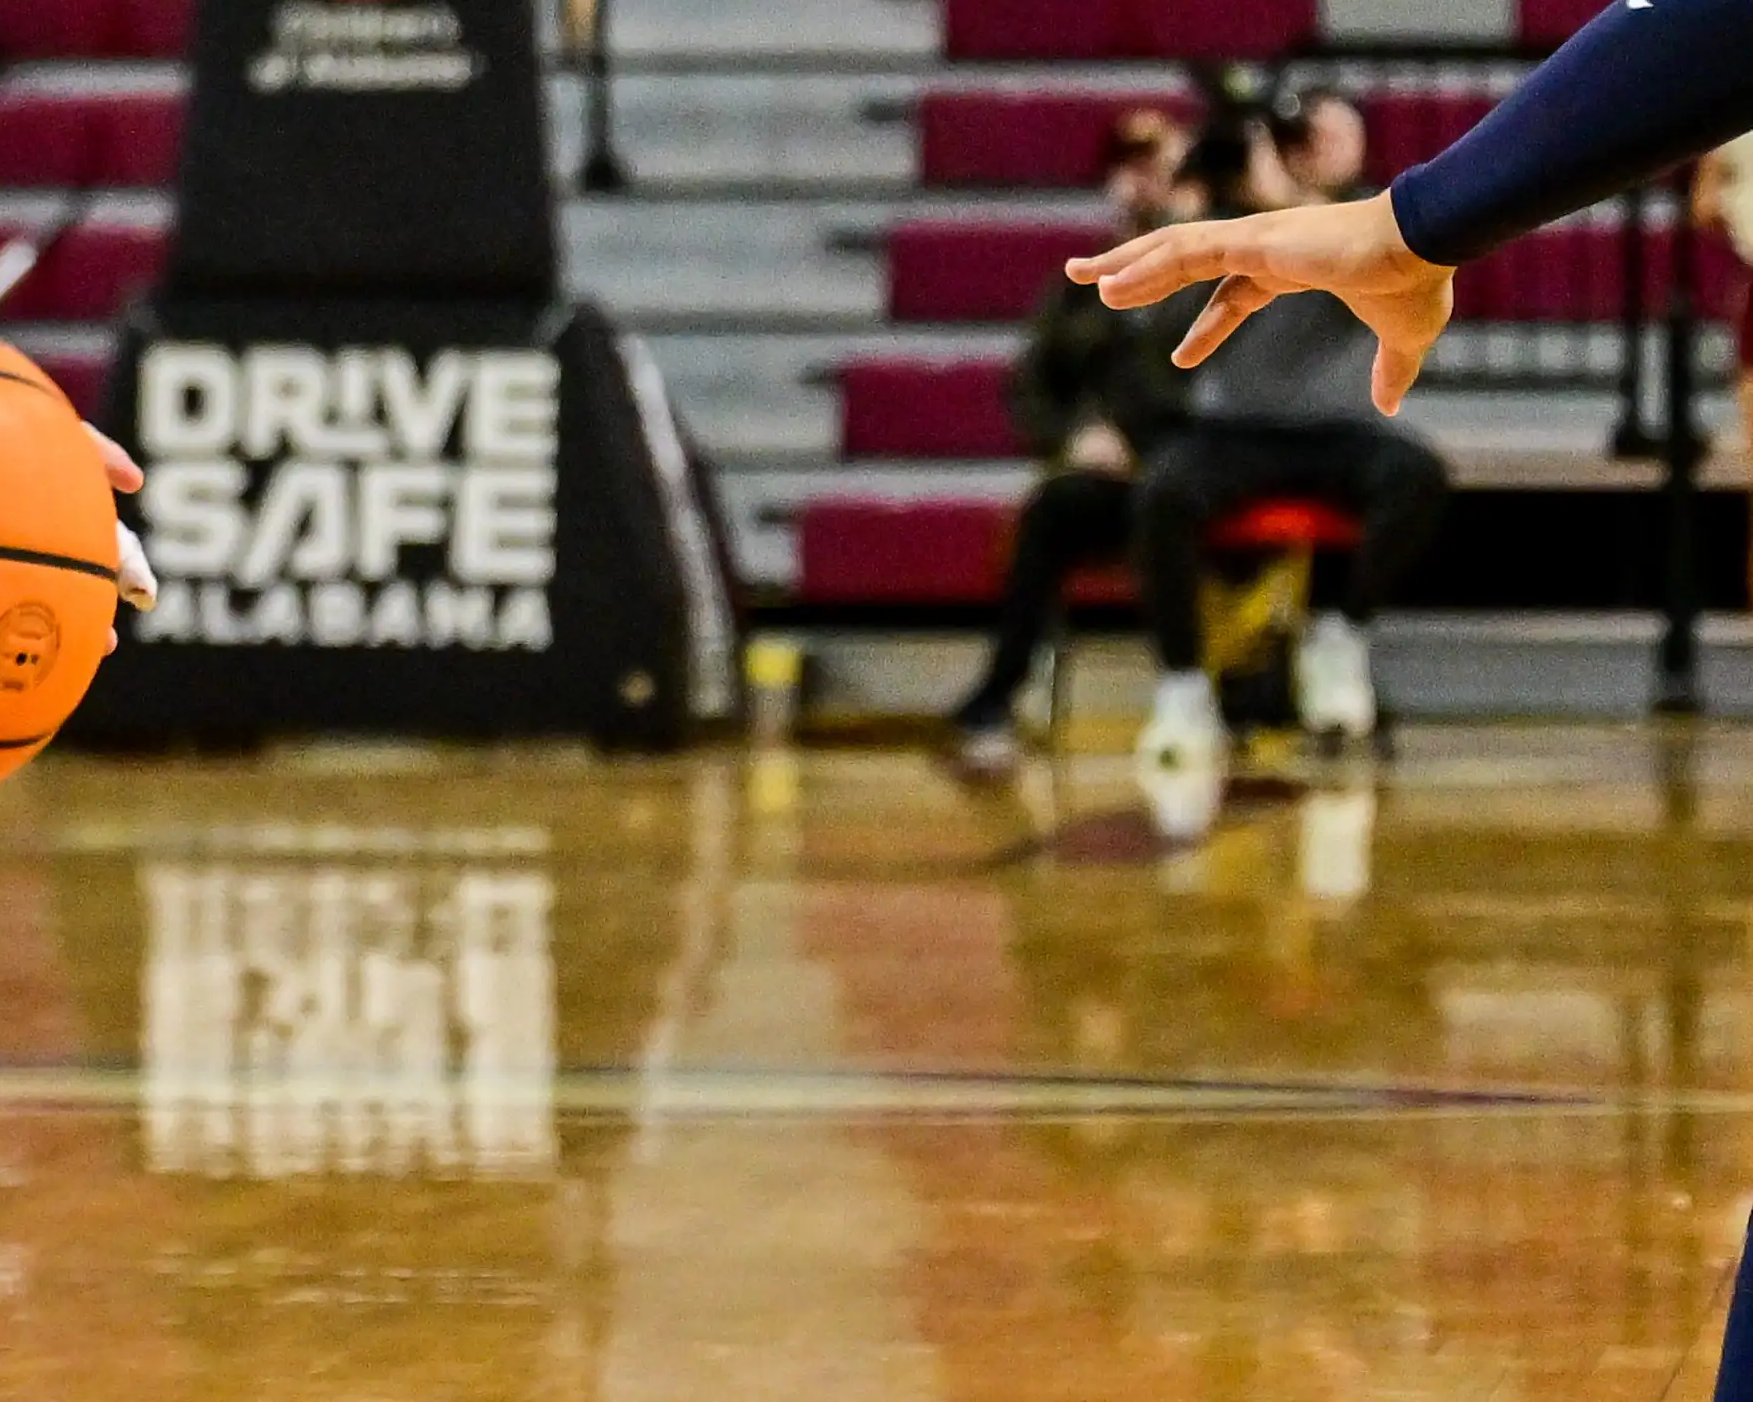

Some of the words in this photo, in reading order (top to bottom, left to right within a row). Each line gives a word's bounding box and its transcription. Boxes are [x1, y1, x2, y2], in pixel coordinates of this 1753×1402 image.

[138, 342, 561, 458] DRIVE
[143, 460, 558, 588] SAFE
[135, 578, 552, 652] ALABAMA
